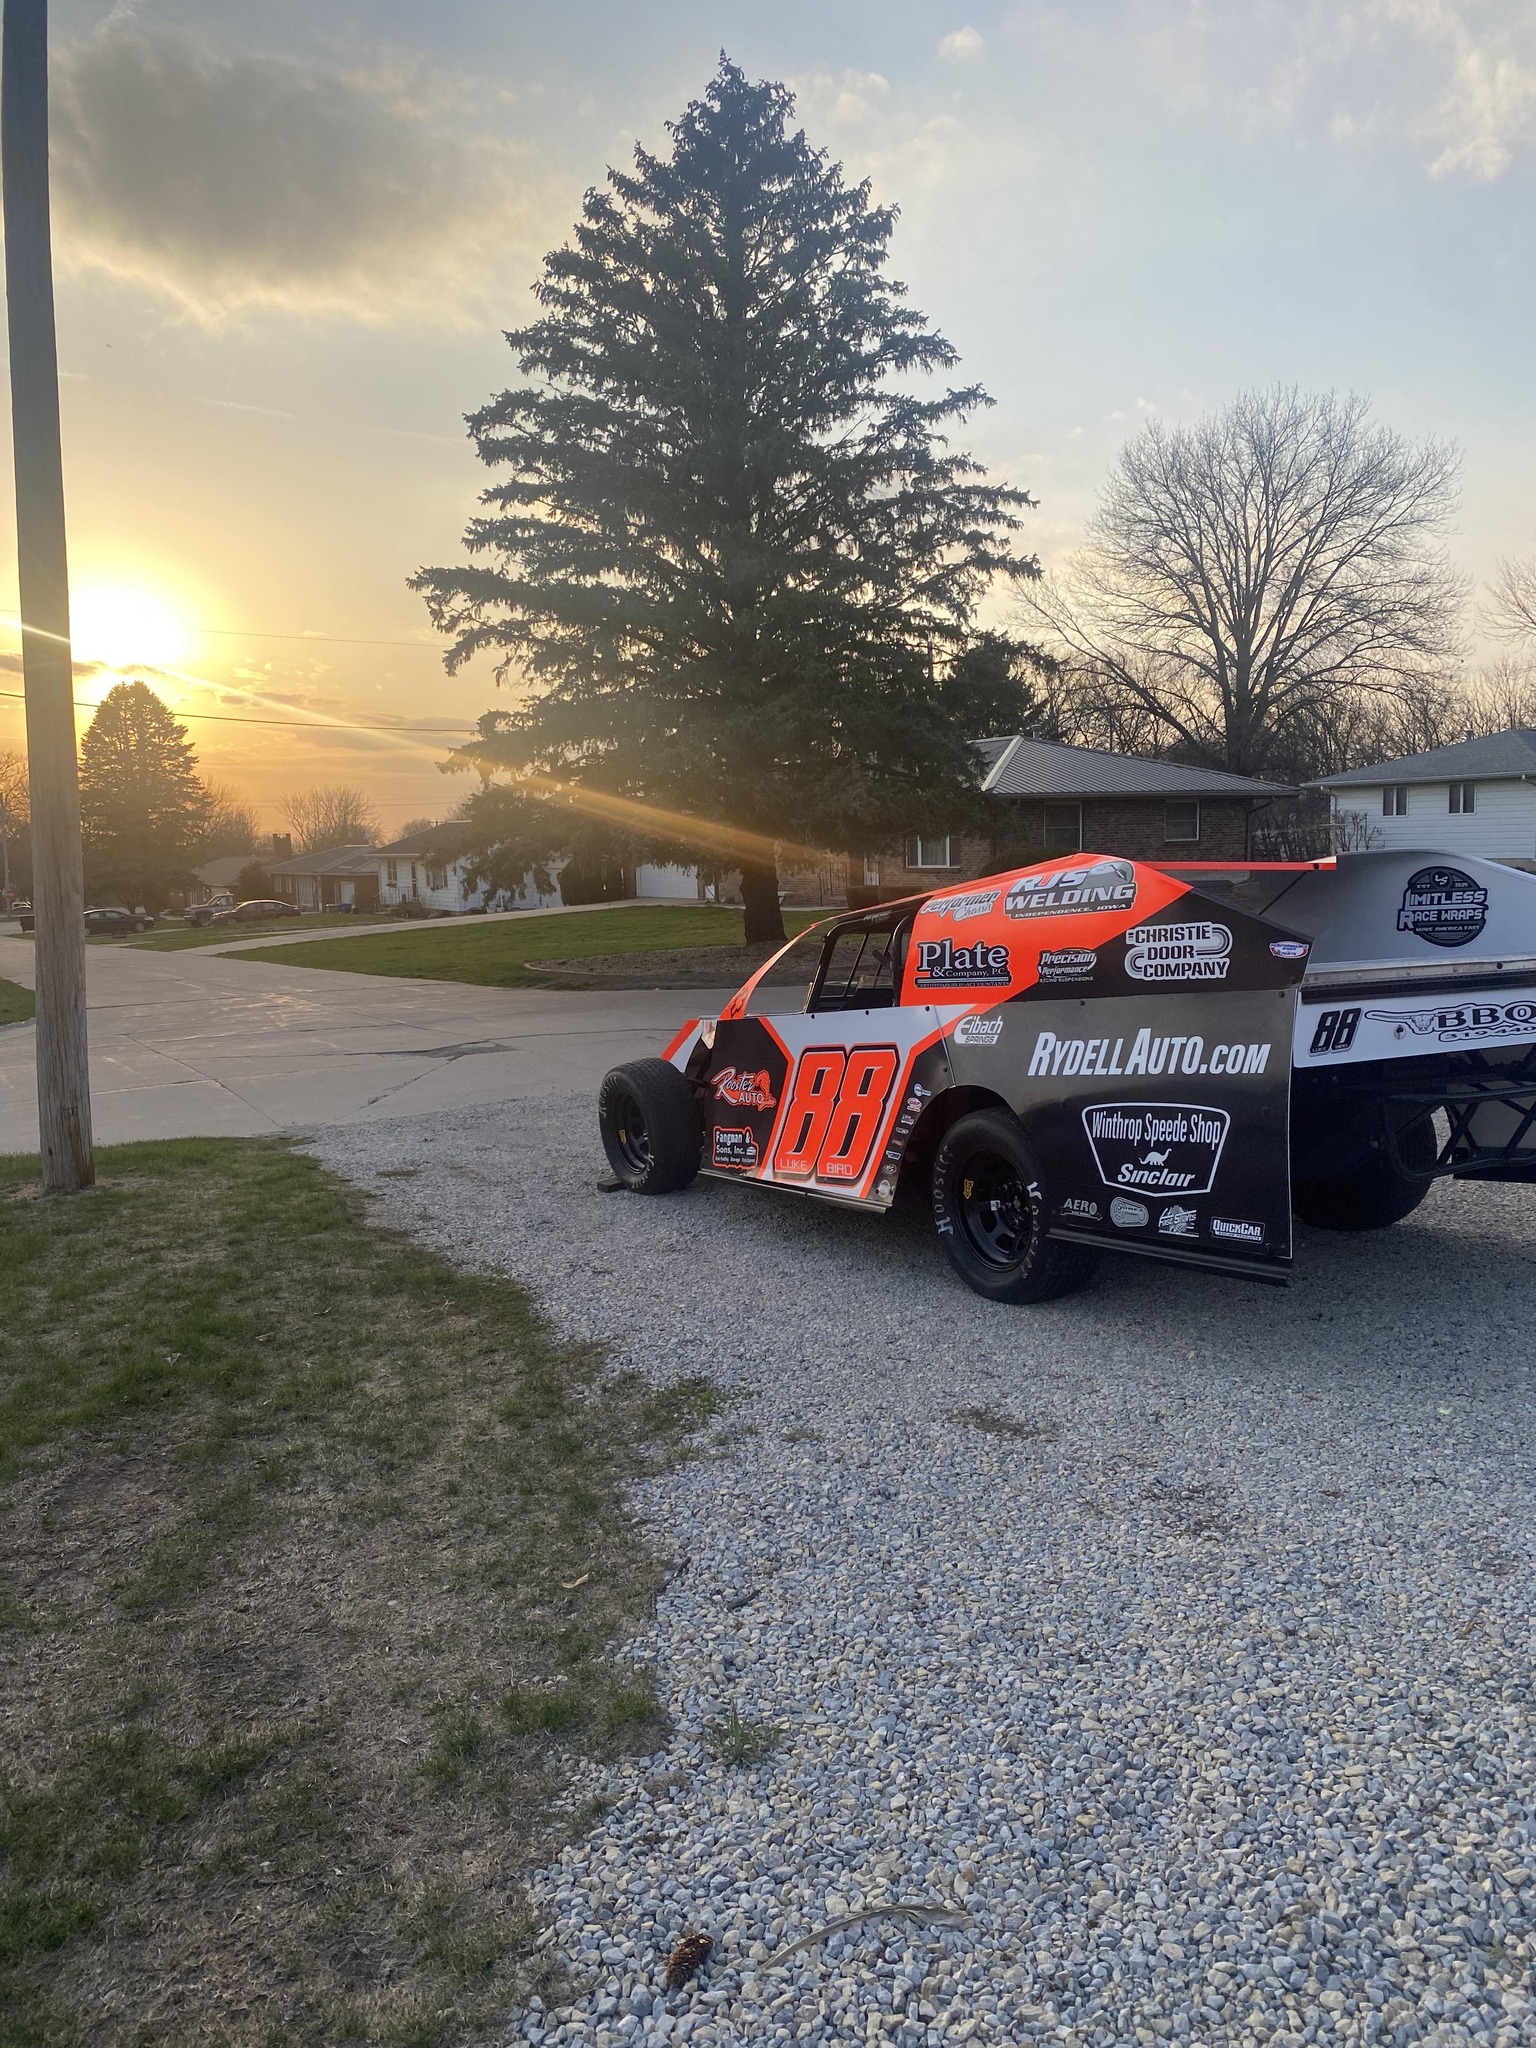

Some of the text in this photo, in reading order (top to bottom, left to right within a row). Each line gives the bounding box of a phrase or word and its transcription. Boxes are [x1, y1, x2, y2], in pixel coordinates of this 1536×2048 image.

[1010, 870, 1090, 893] RJS
[1006, 884, 1136, 910] WELDING
[1404, 889, 1486, 911] LIMITLESS
[954, 903, 991, 919] Chassis
[1399, 909, 1482, 929] RACE WRAPS
[1135, 925, 1210, 944] CHRISTIE
[918, 940, 1007, 970] Plate
[1041, 953, 1096, 965] Precision
[1147, 945, 1194, 961] DOOR
[932, 966, 944, 977] &
[1042, 966, 1088, 976] Performance
[1143, 961, 1228, 978] COMPANY
[954, 1016, 1004, 1034] Eibach
[1438, 1005, 1536, 1029] BBQ
[1310, 1008, 1362, 1054] 88
[713, 1069, 754, 1103] Rooster
[739, 1092, 764, 1104] AUTO
[774, 1045, 900, 1182] 88
[716, 1131, 750, 1146] Fangman &
[1092, 1111, 1221, 1150] Winthrop Speede Shop
[716, 1145, 745, 1154] Sons, Inc.
[780, 1158, 852, 1176] LUKE BIRD
[1118, 1164, 1196, 1187] Sinclair
[1064, 1198, 1098, 1216] AERO
